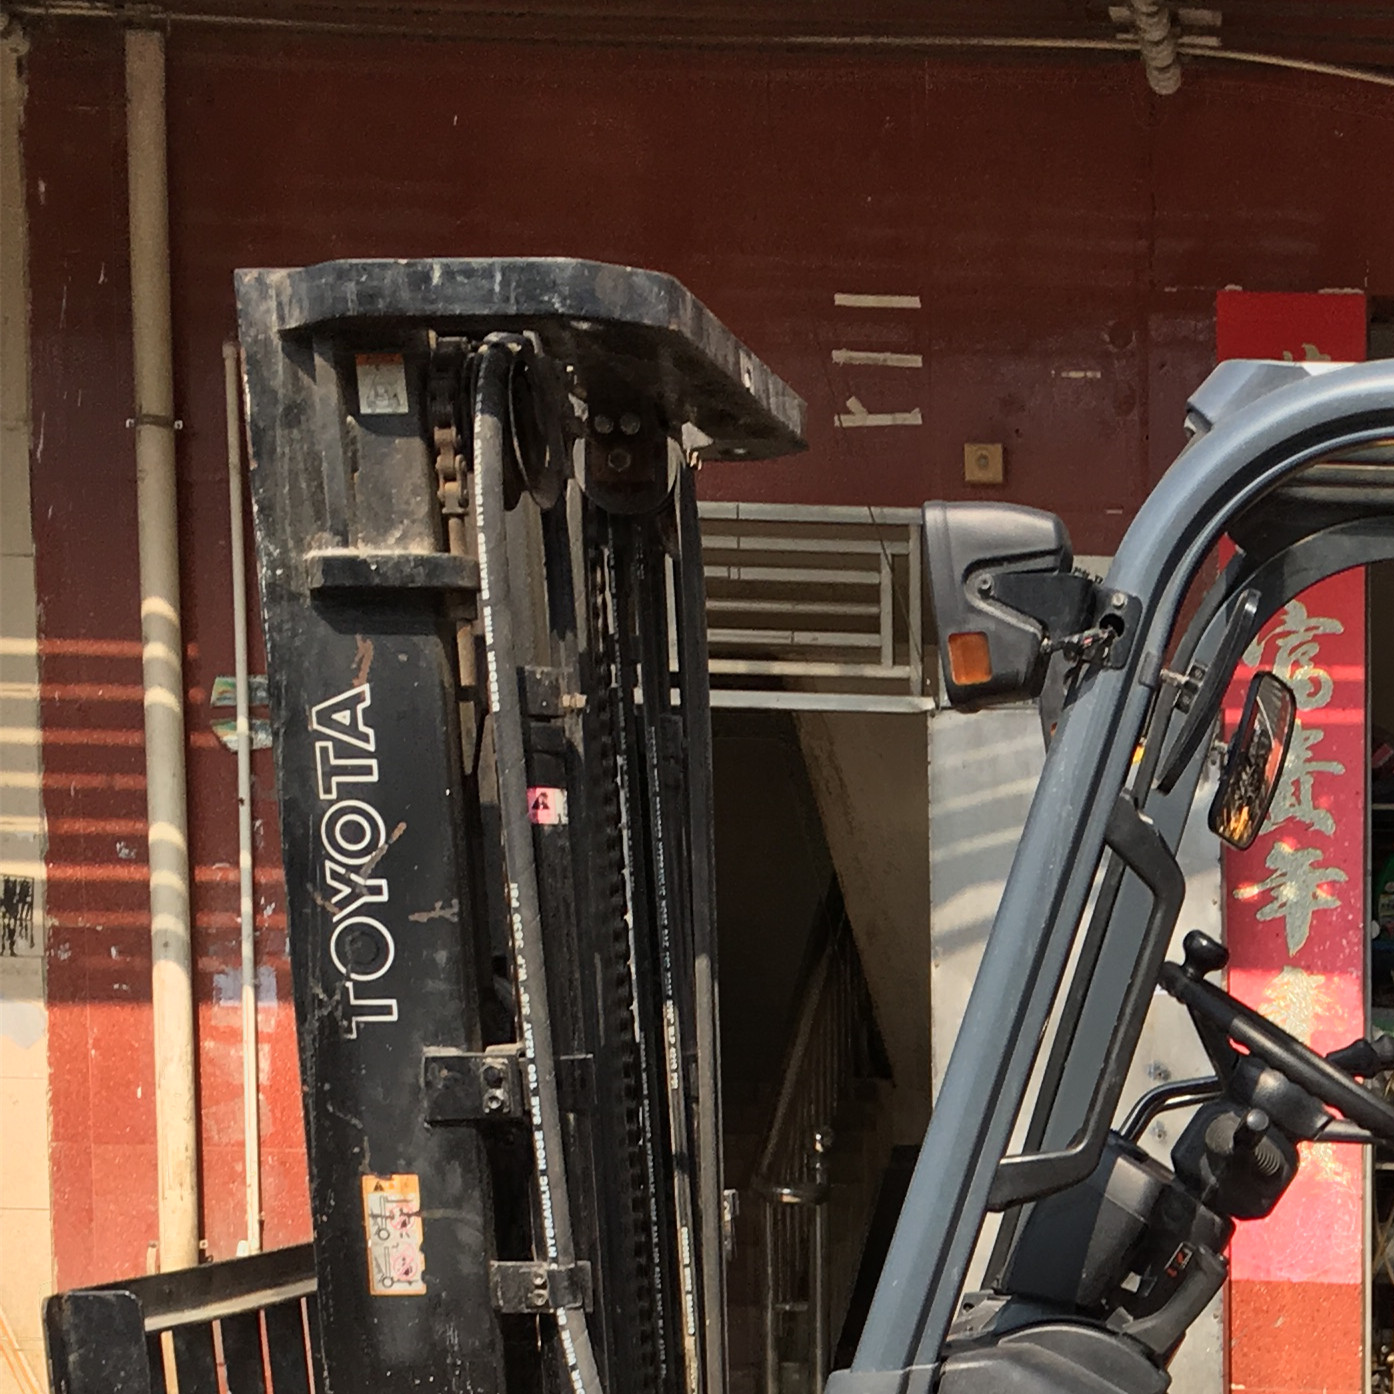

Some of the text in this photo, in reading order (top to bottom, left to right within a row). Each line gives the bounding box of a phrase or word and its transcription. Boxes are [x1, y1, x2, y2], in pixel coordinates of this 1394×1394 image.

[473, 439, 485, 526] HYDRAULIC
[477, 533, 490, 599] BRAIDED
[483, 605, 494, 645] WIRE
[309, 681, 399, 1041] TOYOTA
[527, 1063, 538, 1090] 100
[531, 1096, 542, 1126] SAE
[534, 1130, 547, 1170] HOSE
[539, 1175, 558, 1258] HYDRAULIC
